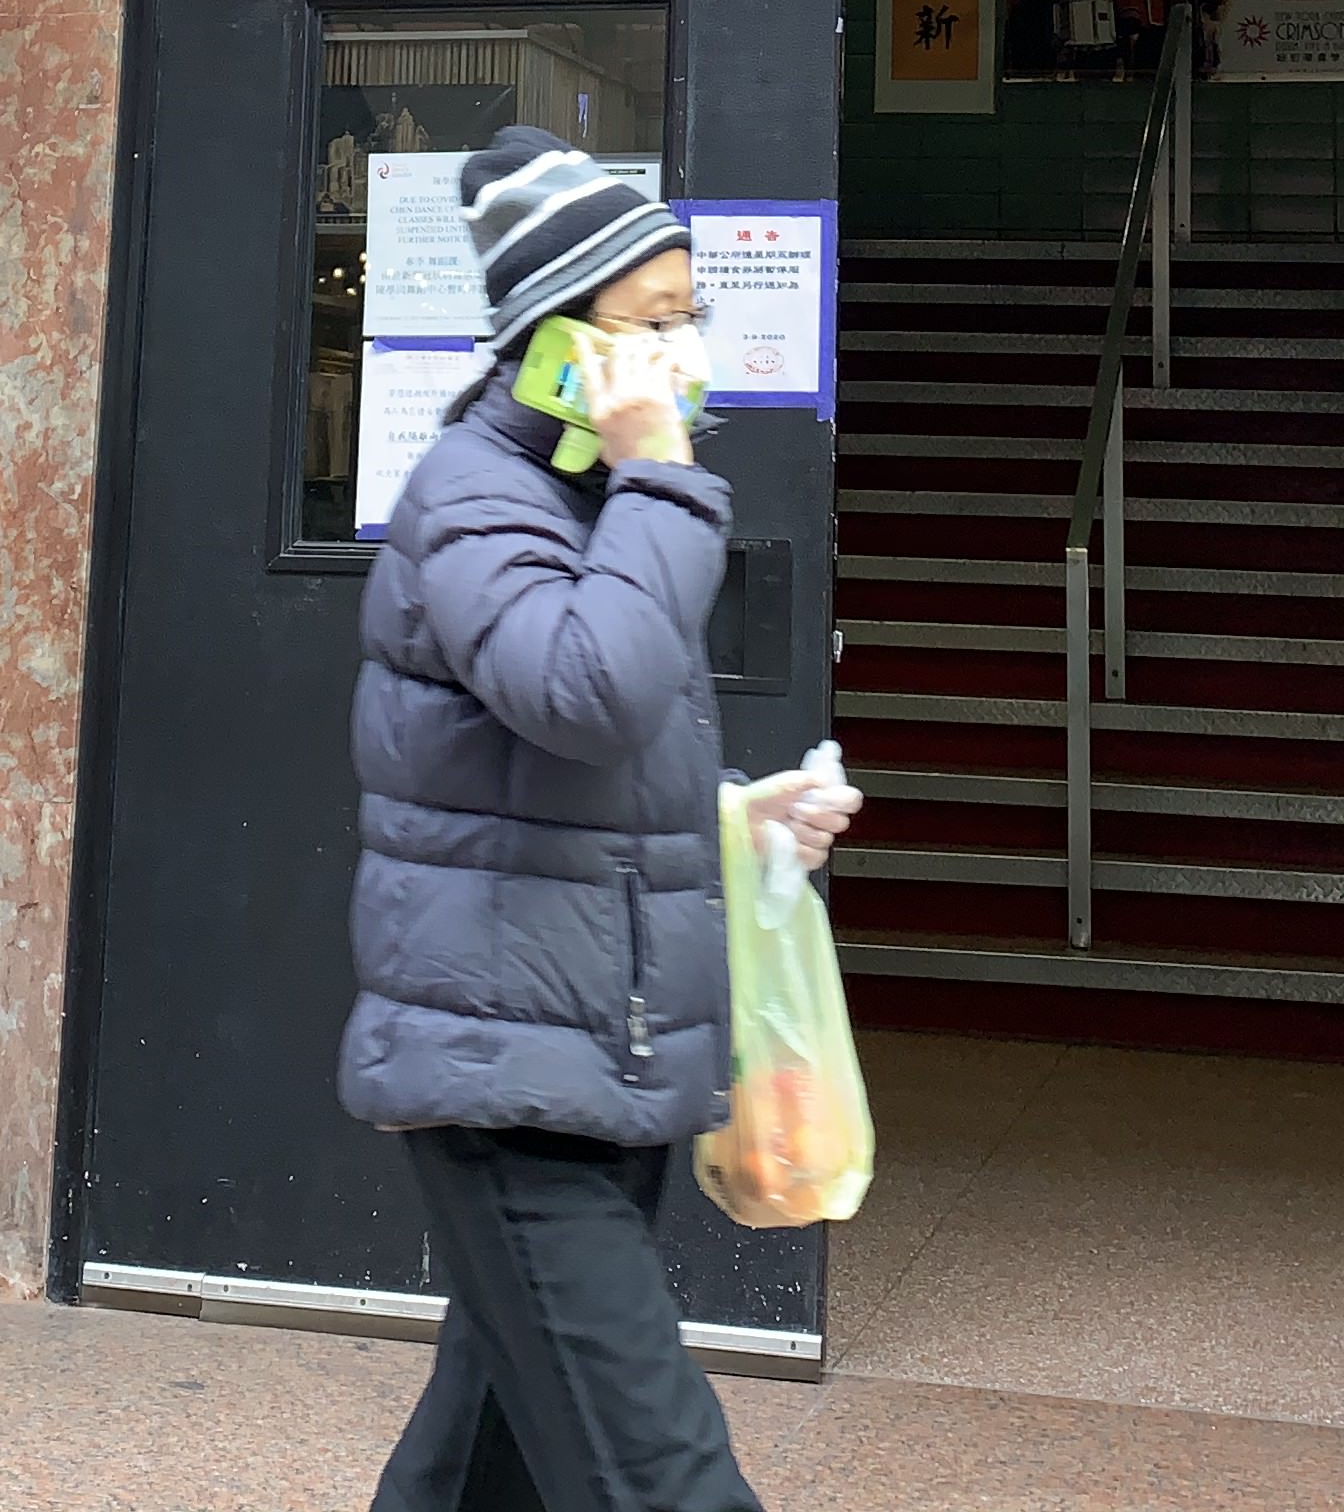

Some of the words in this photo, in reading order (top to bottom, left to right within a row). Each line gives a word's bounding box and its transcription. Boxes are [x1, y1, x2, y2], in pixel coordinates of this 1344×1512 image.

[399, 196, 416, 204] DUE
[419, 196, 430, 204] TO
[398, 216, 434, 224] CLASSES
[396, 226, 444, 234] SUSPENDED
[398, 236, 435, 244] FURTHER
